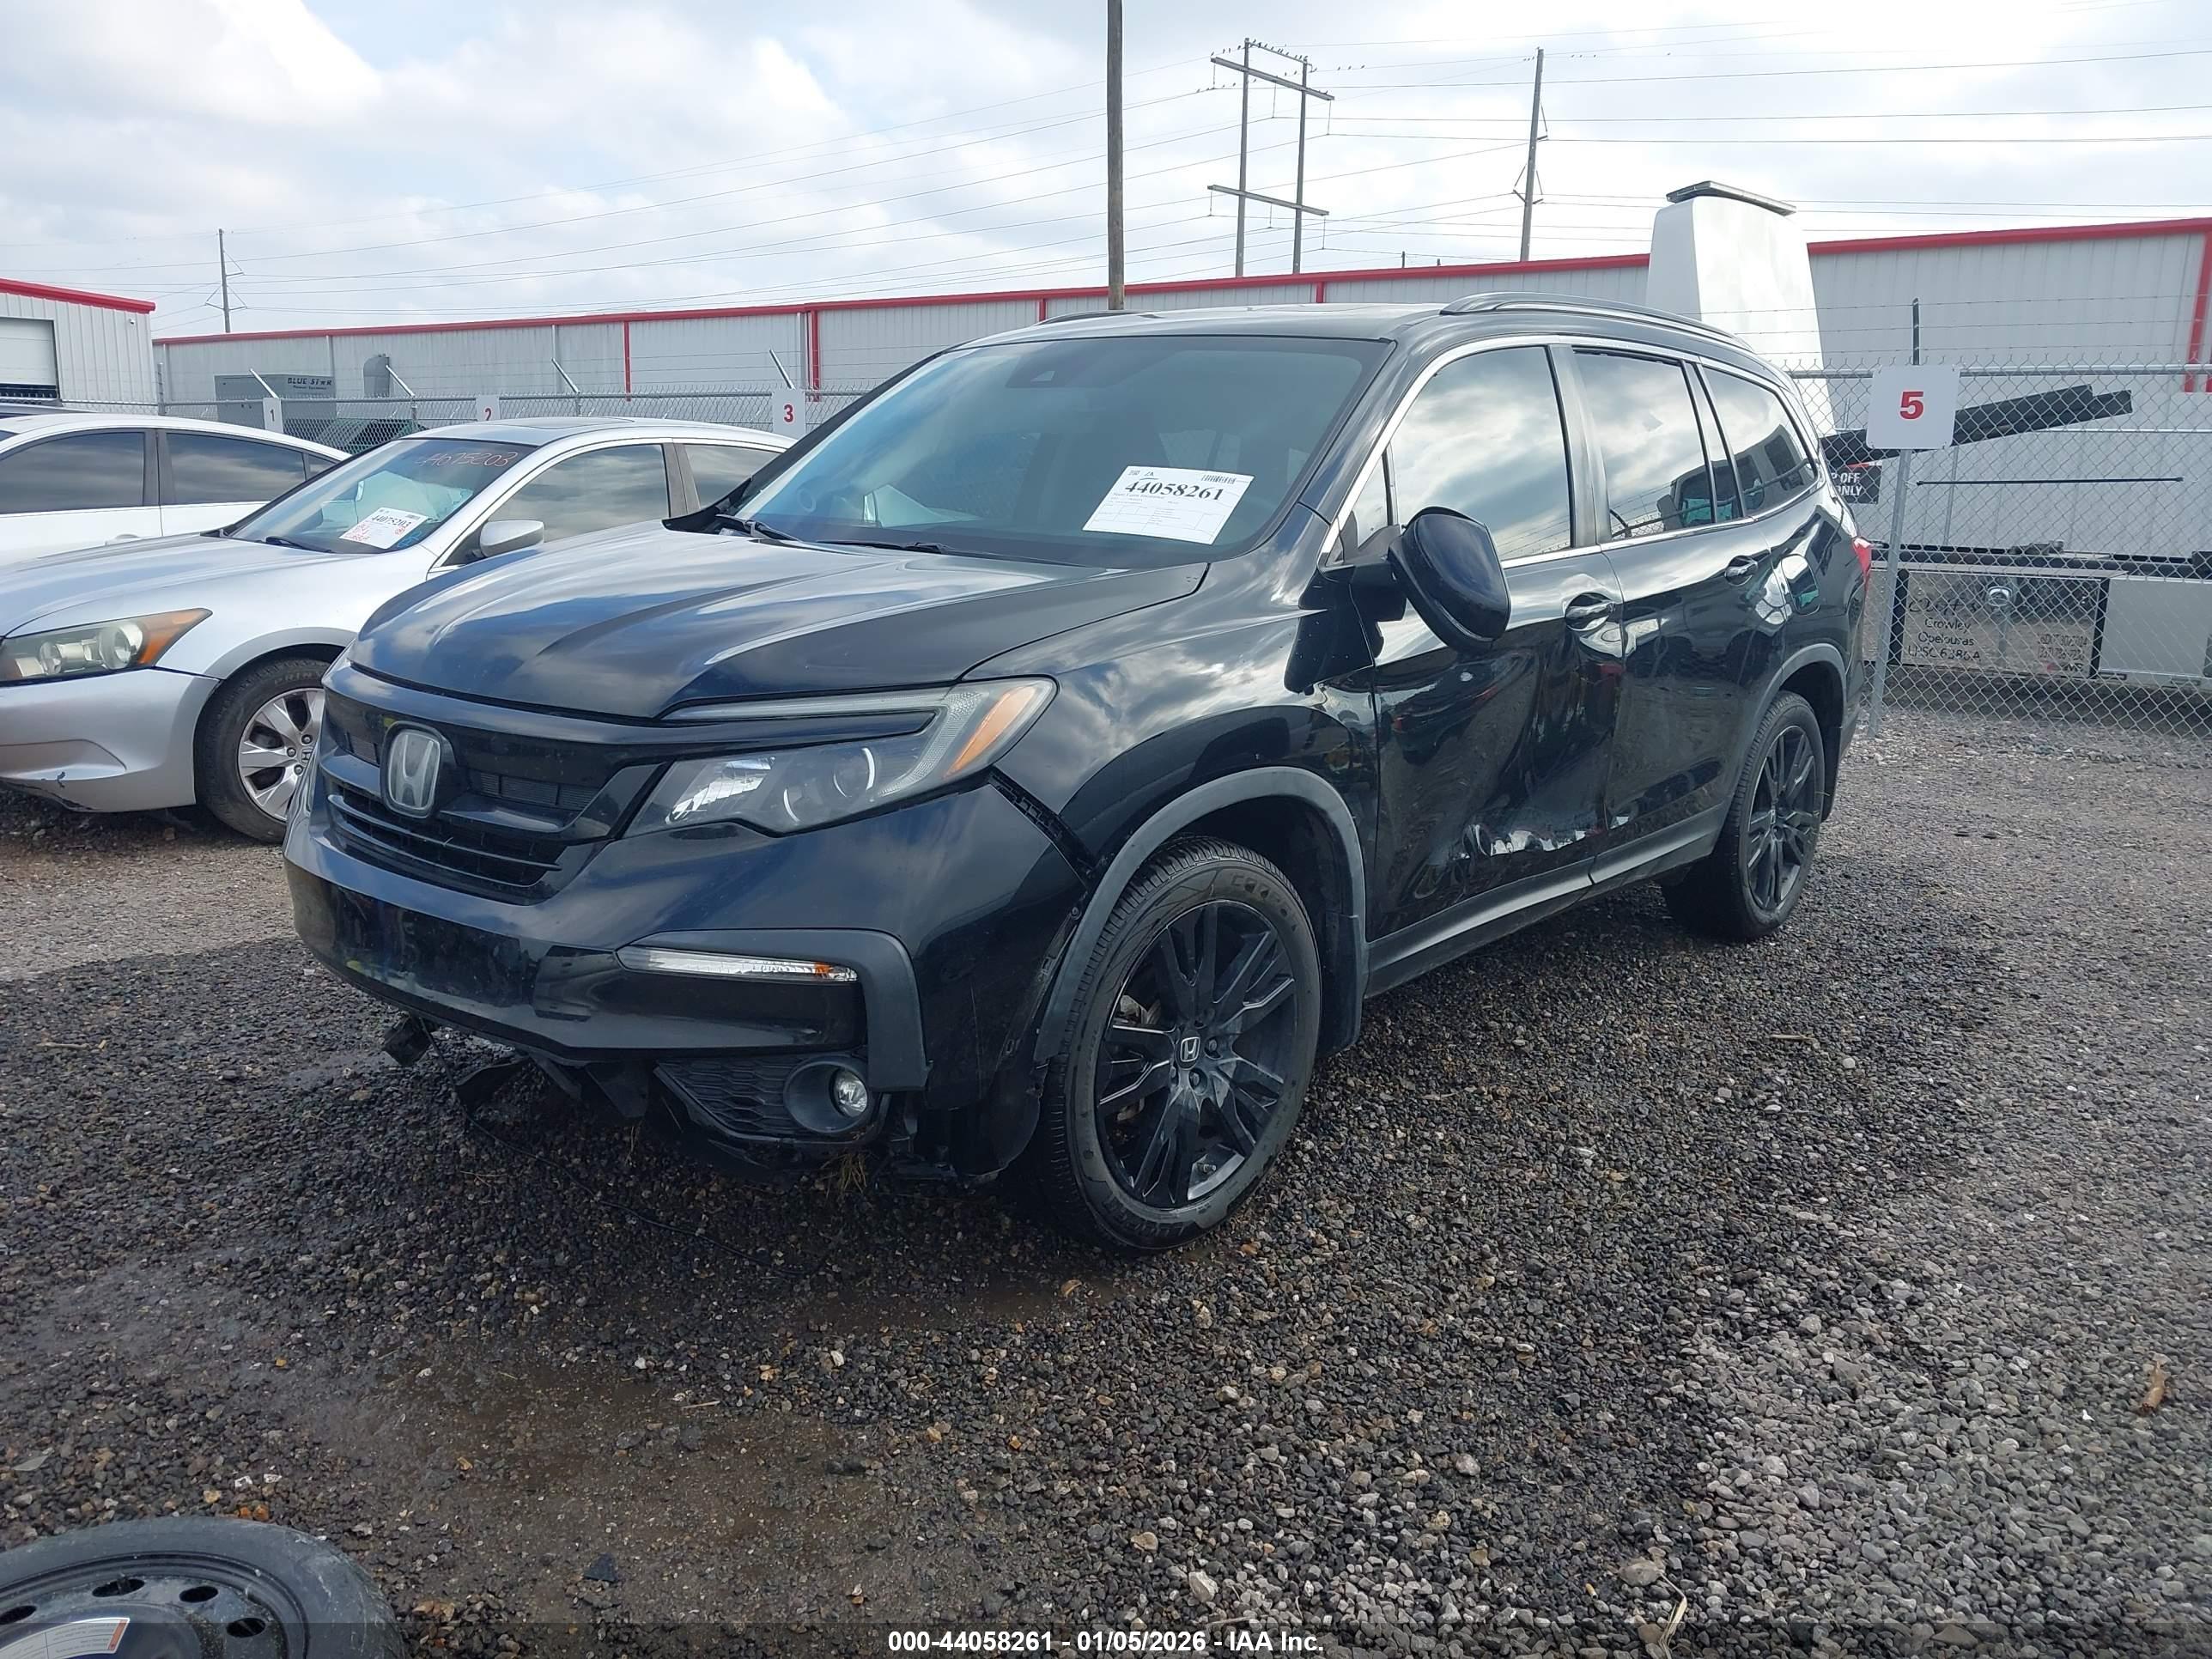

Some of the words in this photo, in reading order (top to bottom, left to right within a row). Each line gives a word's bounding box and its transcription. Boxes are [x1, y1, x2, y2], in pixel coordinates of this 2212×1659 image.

[783, 404, 794, 422] 3
[1899, 391, 1924, 420] 5
[270, 409, 275, 422] 1
[484, 407, 492, 422] 2
[1840, 472, 1861, 483] OFF
[1125, 481, 1224, 501] 44058261
[1925, 617, 1972, 634] Crowley
[1918, 631, 1975, 646] Opelousas
